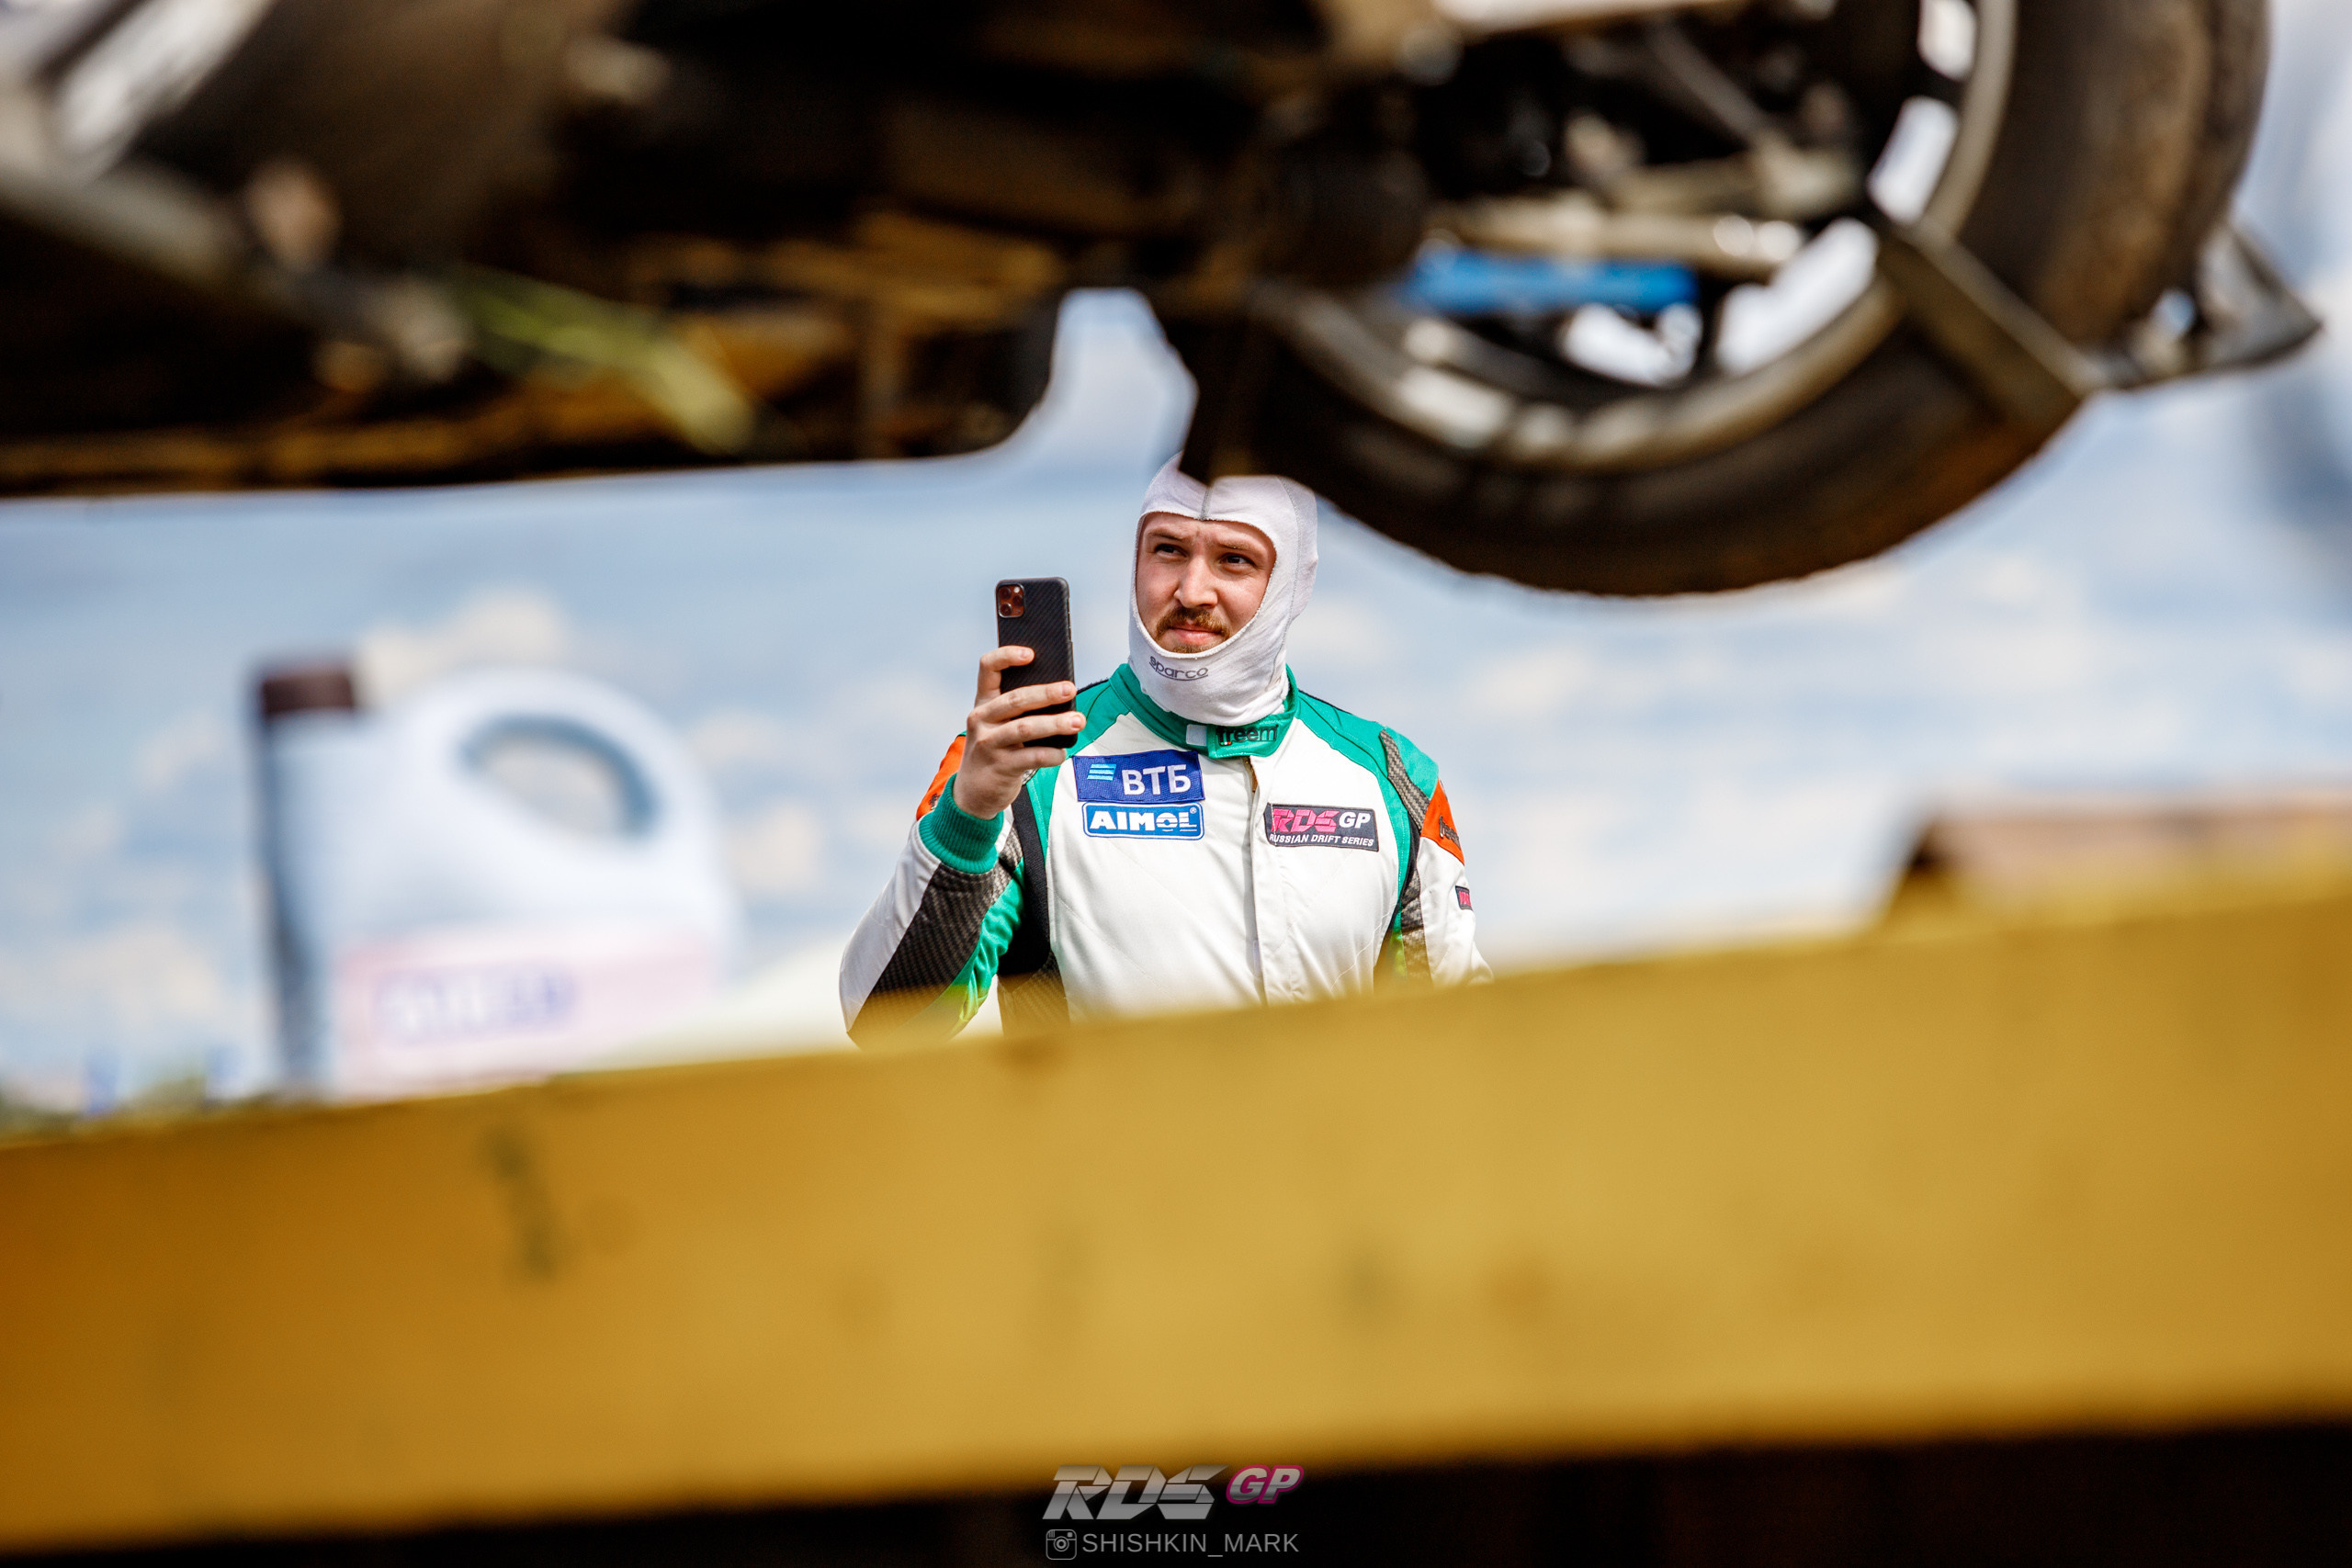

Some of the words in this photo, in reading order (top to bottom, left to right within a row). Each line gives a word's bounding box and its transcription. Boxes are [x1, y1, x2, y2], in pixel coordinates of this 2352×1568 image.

[1148, 655, 1209, 679] sparco
[1216, 725, 1278, 746] freem
[1122, 763, 1192, 795] ВТБ
[1272, 808, 1340, 833] RDS
[1339, 811, 1371, 829] GP
[1269, 833, 1309, 844] RUSSIAN
[1310, 833, 1340, 844] DRIFT
[1341, 835, 1374, 847] SERIES
